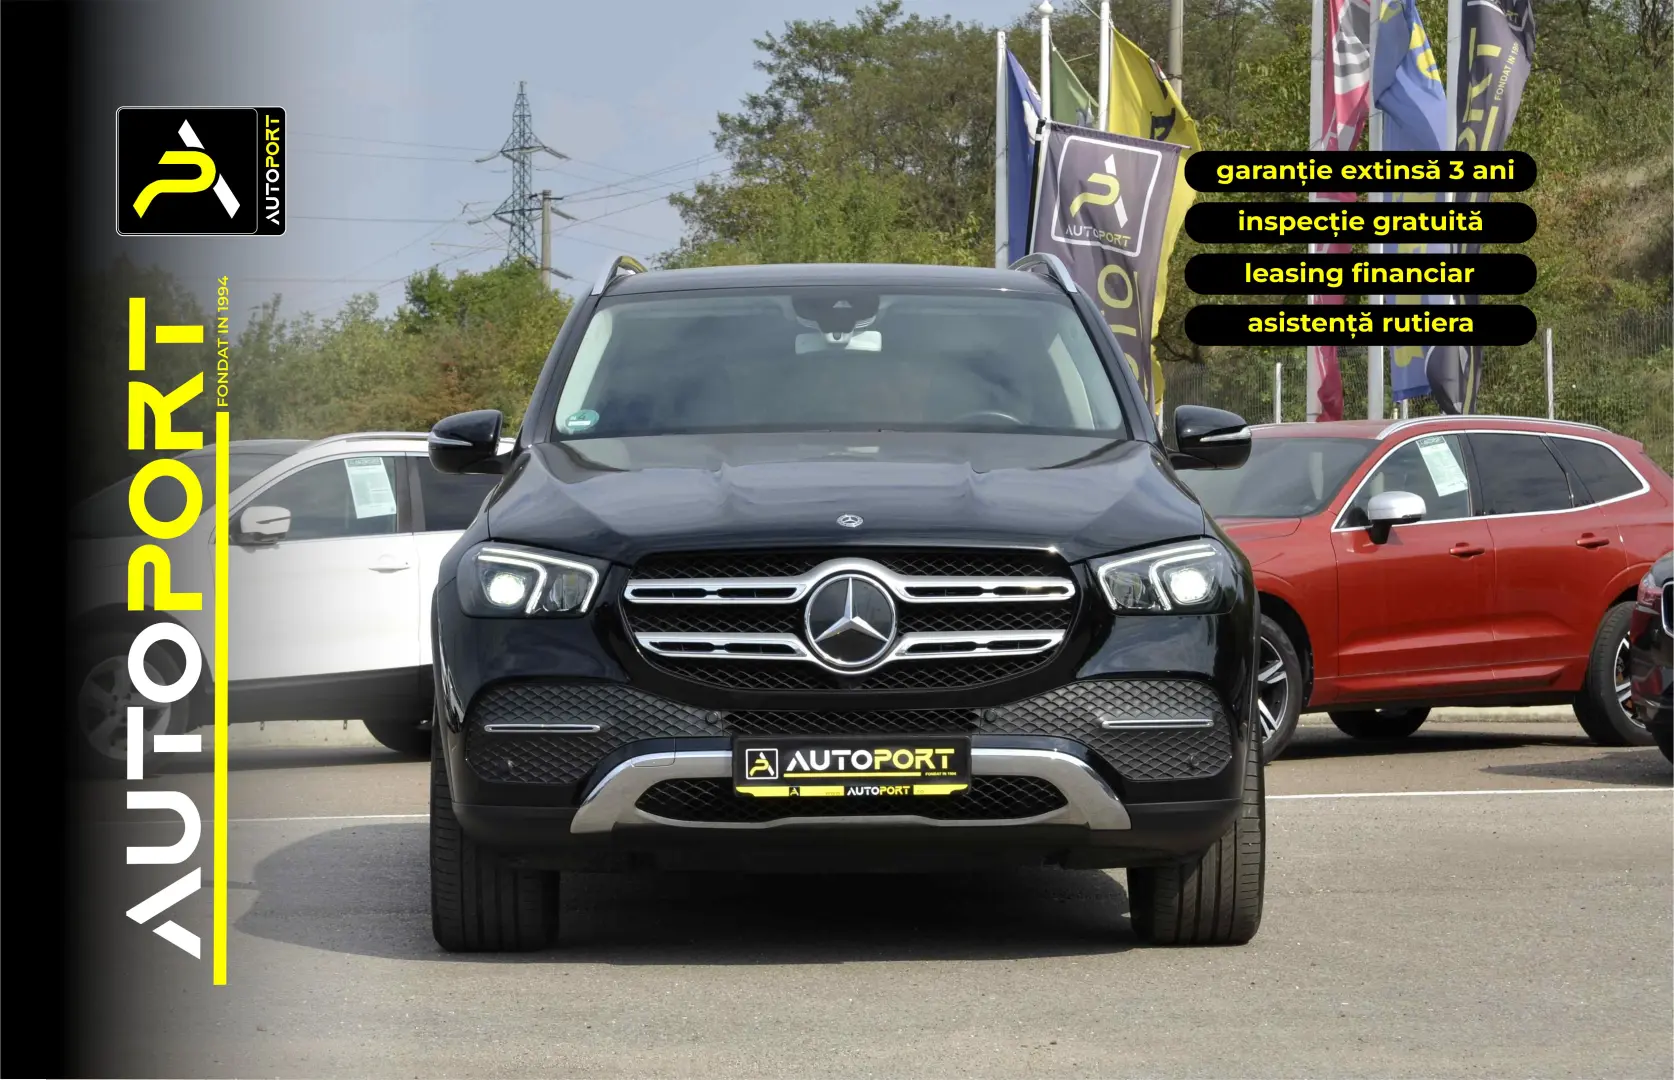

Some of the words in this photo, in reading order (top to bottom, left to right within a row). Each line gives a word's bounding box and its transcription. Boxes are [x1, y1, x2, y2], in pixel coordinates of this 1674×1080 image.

[1065, 224, 1132, 248] AUTOPORT
[786, 748, 955, 772] AUTOPORT
[846, 785, 911, 796] AUTOPORT
